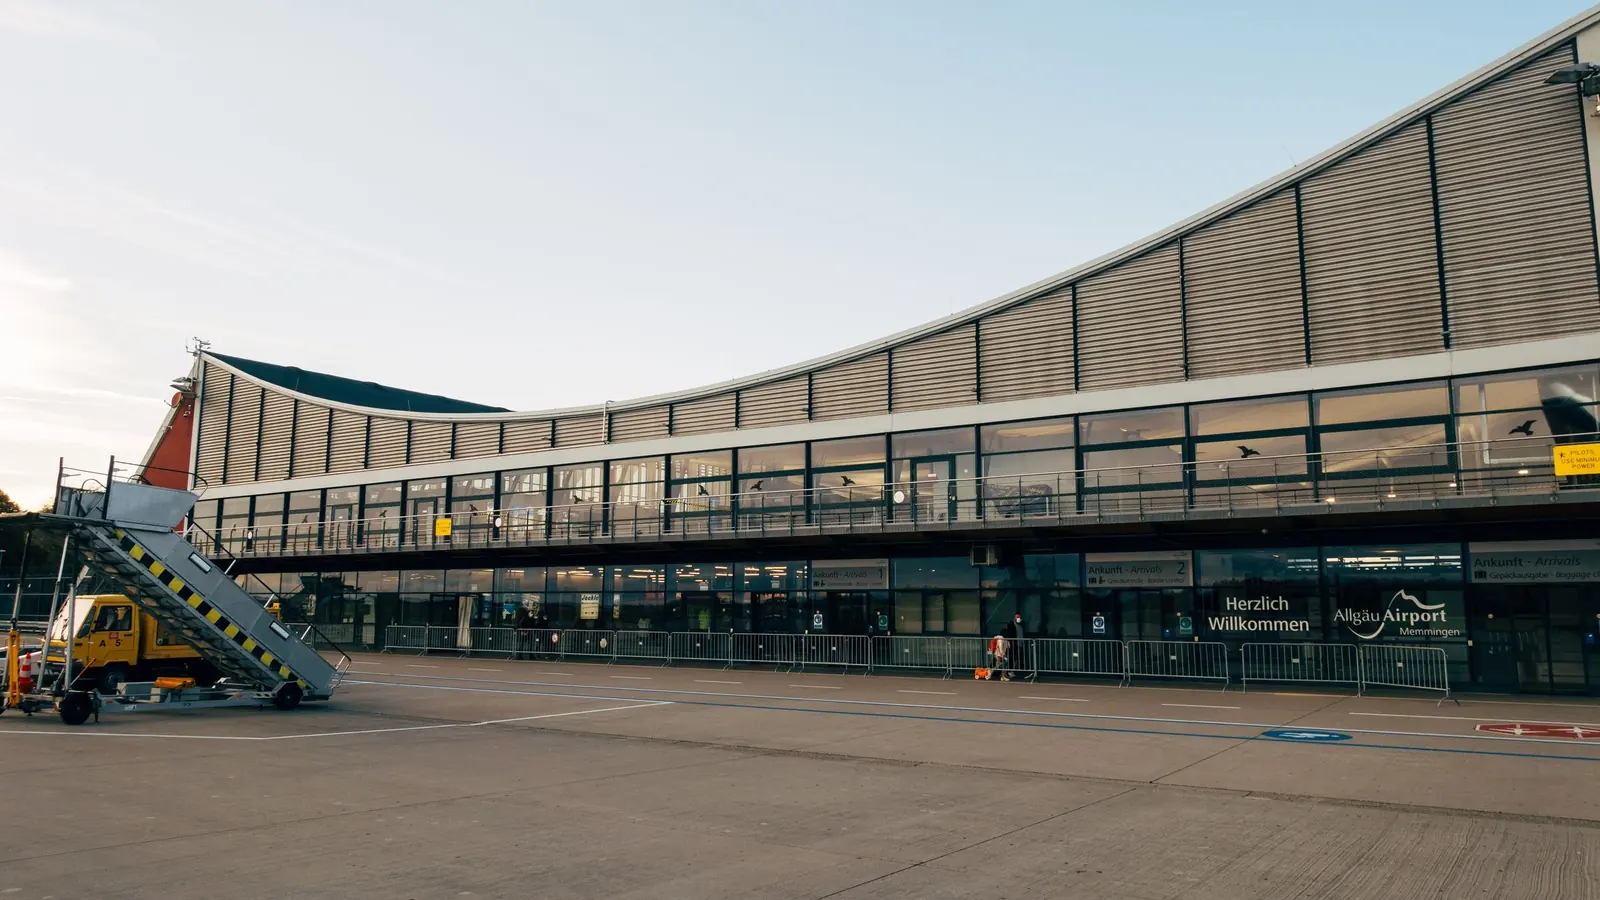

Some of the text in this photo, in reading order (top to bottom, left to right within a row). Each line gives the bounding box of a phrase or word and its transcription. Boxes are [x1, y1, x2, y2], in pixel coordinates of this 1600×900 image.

[1474, 556, 1523, 567] Ankunft
[1534, 555, 1581, 567] Arrivals
[878, 568, 883, 579] 1
[1088, 565, 1122, 574] Ankunft
[1130, 564, 1163, 574] Arrivals
[1177, 561, 1185, 575] 2
[1226, 595, 1289, 611] Herzlich
[1333, 608, 1447, 626] Allgäu Airport
[1208, 616, 1310, 632] Willkommen
[1399, 627, 1460, 638] Memmingen
[99, 639, 106, 647] A
